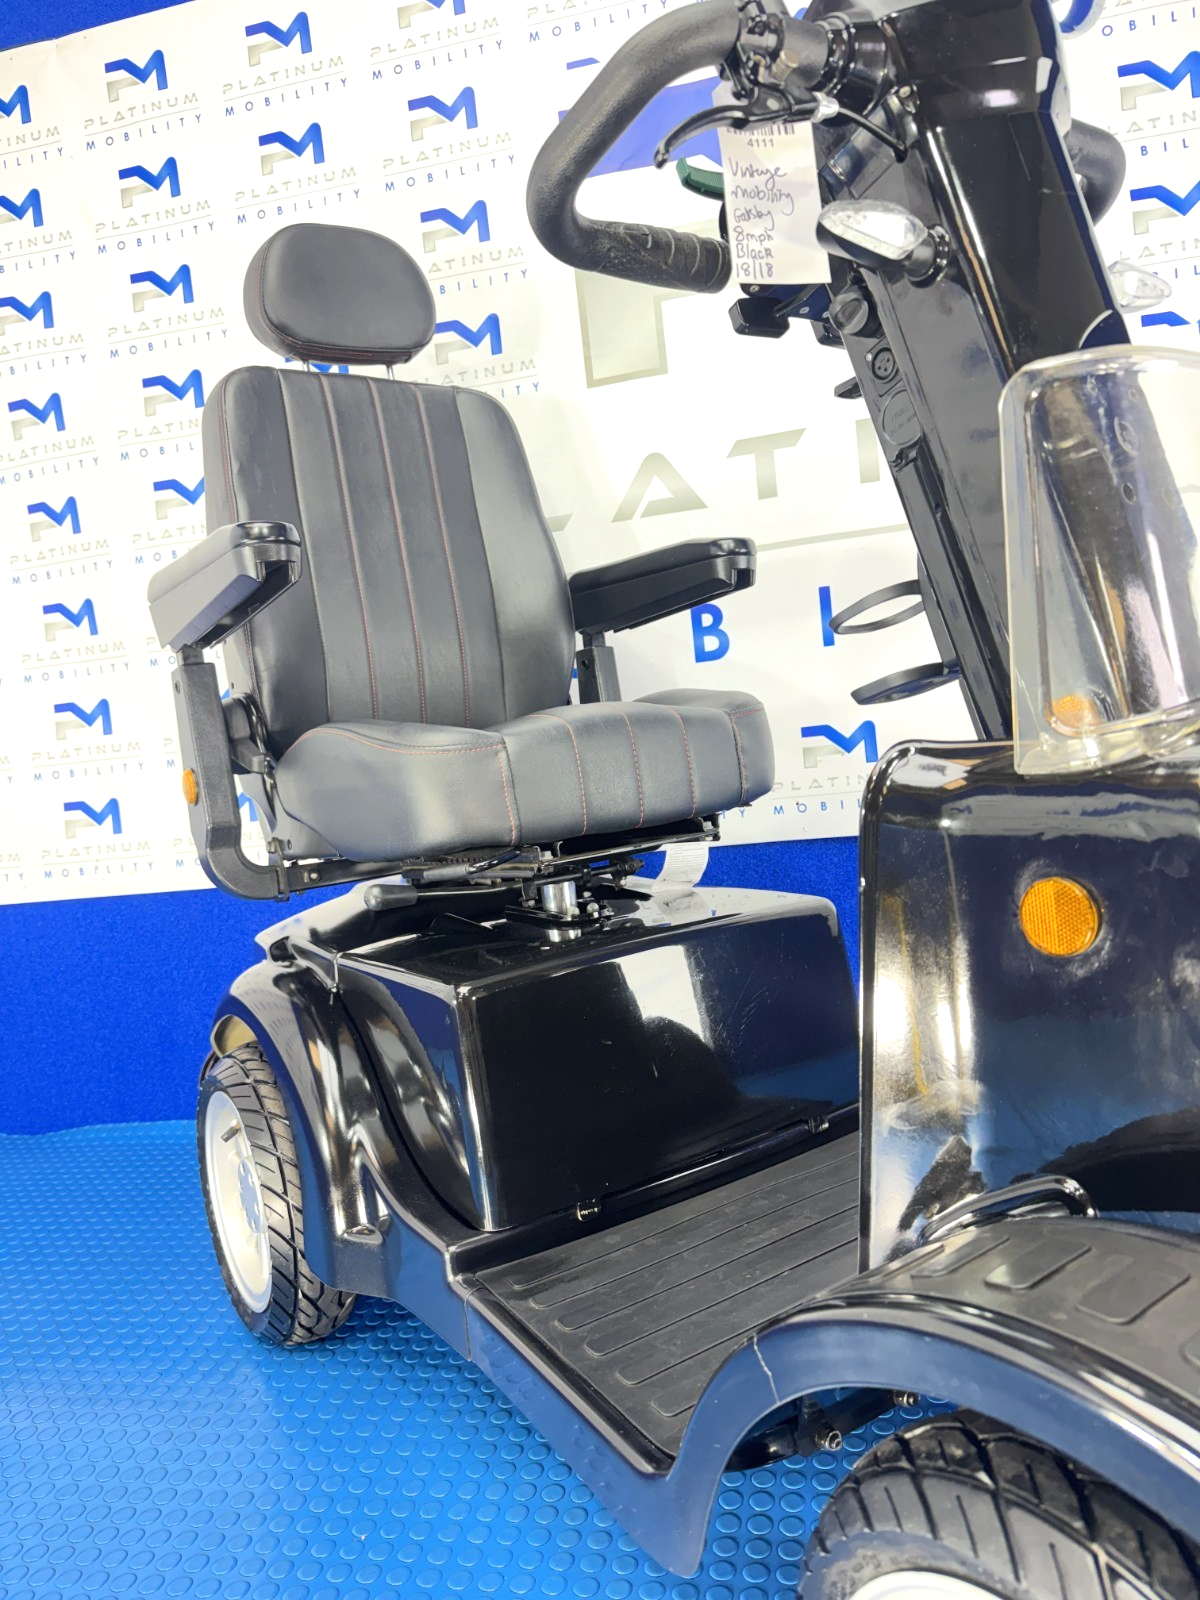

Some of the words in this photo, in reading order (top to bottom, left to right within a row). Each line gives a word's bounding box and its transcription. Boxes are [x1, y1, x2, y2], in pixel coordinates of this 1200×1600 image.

[529, 0, 667, 43] MOBILITY
[1101, 6, 1195, 37] OBILI
[370, 16, 499, 58] PLATINUM
[372, 39, 502, 81] MOBILITY
[222, 55, 345, 95] PLATINUM
[225, 77, 347, 117] MOBILITY
[83, 92, 199, 130] PLATINUM
[1107, 109, 1196, 137] LATIN
[86, 113, 202, 151] MOBILITY
[747, 138, 775, 148] 4111
[3, 147, 64, 169] ILITY
[382, 131, 512, 169] PLATINUM
[234, 166, 357, 202] PLATINUM
[385, 154, 515, 192] MOBILITY
[728, 157, 787, 191] Vintage
[94, 199, 211, 234] PLATINUM
[237, 189, 360, 225] MOBILITY
[734, 205, 775, 231] Gatsby
[3, 229, 73, 252] TINUM
[97, 221, 215, 254] MOBILITY
[733, 225, 774, 247] 8mph
[0, 251, 76, 274] BILITY
[427, 246, 525, 274] ATINUM
[439, 268, 528, 295] BILITY
[107, 306, 225, 338] PLATINUM
[0, 332, 84, 357] ATINUM
[110, 328, 228, 359] MOBILITY
[0, 354, 87, 378] BILITY
[117, 418, 199, 440] PLATIN
[120, 441, 195, 462] MOBIL
[9, 537, 110, 566] PLATINUM
[12, 559, 113, 585] MOBILITY
[21, 640, 126, 664] PLATINUM
[24, 661, 130, 684] MOBILITY
[31, 740, 142, 762] PLATINUM
[33, 761, 144, 782] MOBILITY
[772, 774, 869, 792] PLATIN
[773, 798, 862, 816] MOBIL
[41, 840, 151, 860] PLATINUM
[44, 861, 153, 880] MOBILITY
